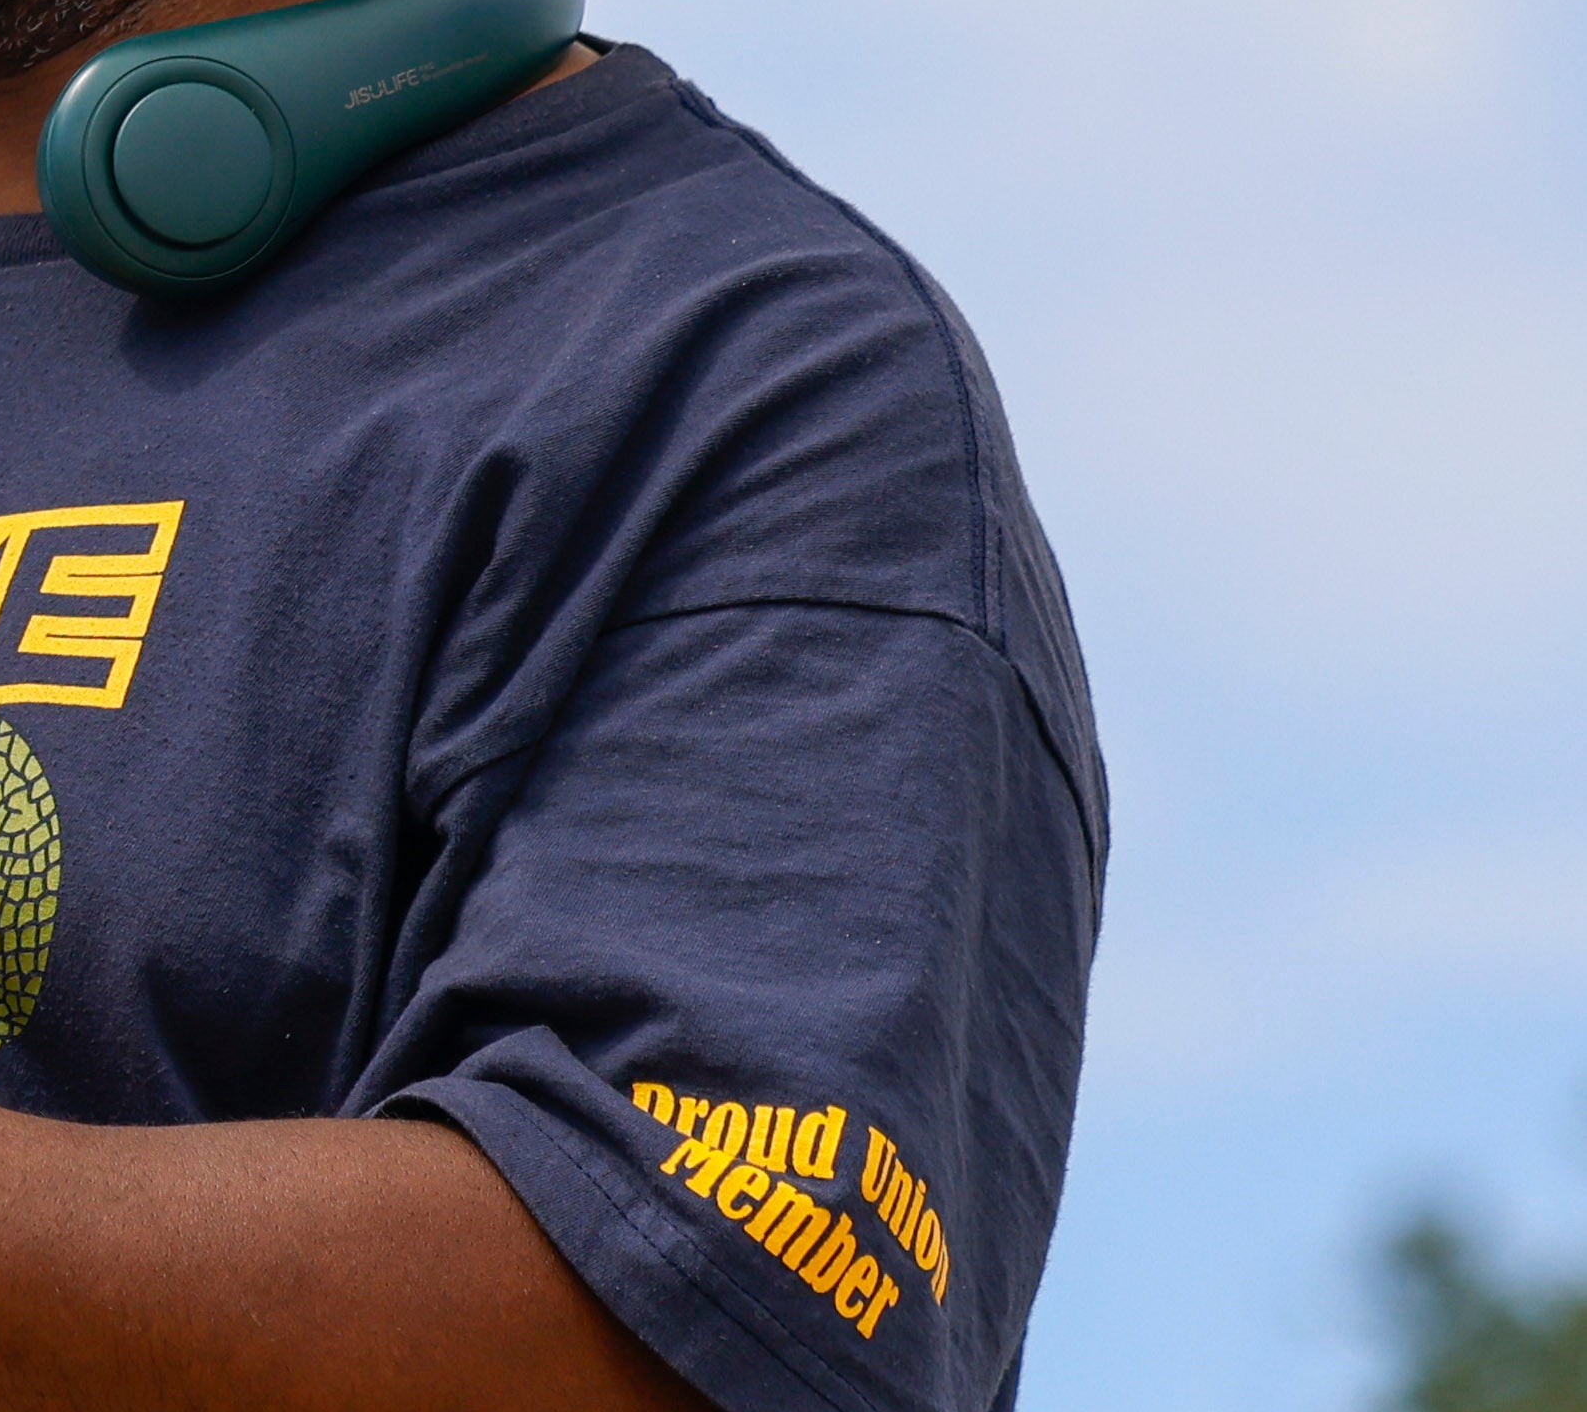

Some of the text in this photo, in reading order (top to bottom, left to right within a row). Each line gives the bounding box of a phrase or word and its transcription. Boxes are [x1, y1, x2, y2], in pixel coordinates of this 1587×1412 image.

[631, 1081, 951, 1307] Proud Union
[658, 1134, 901, 1340] Member
